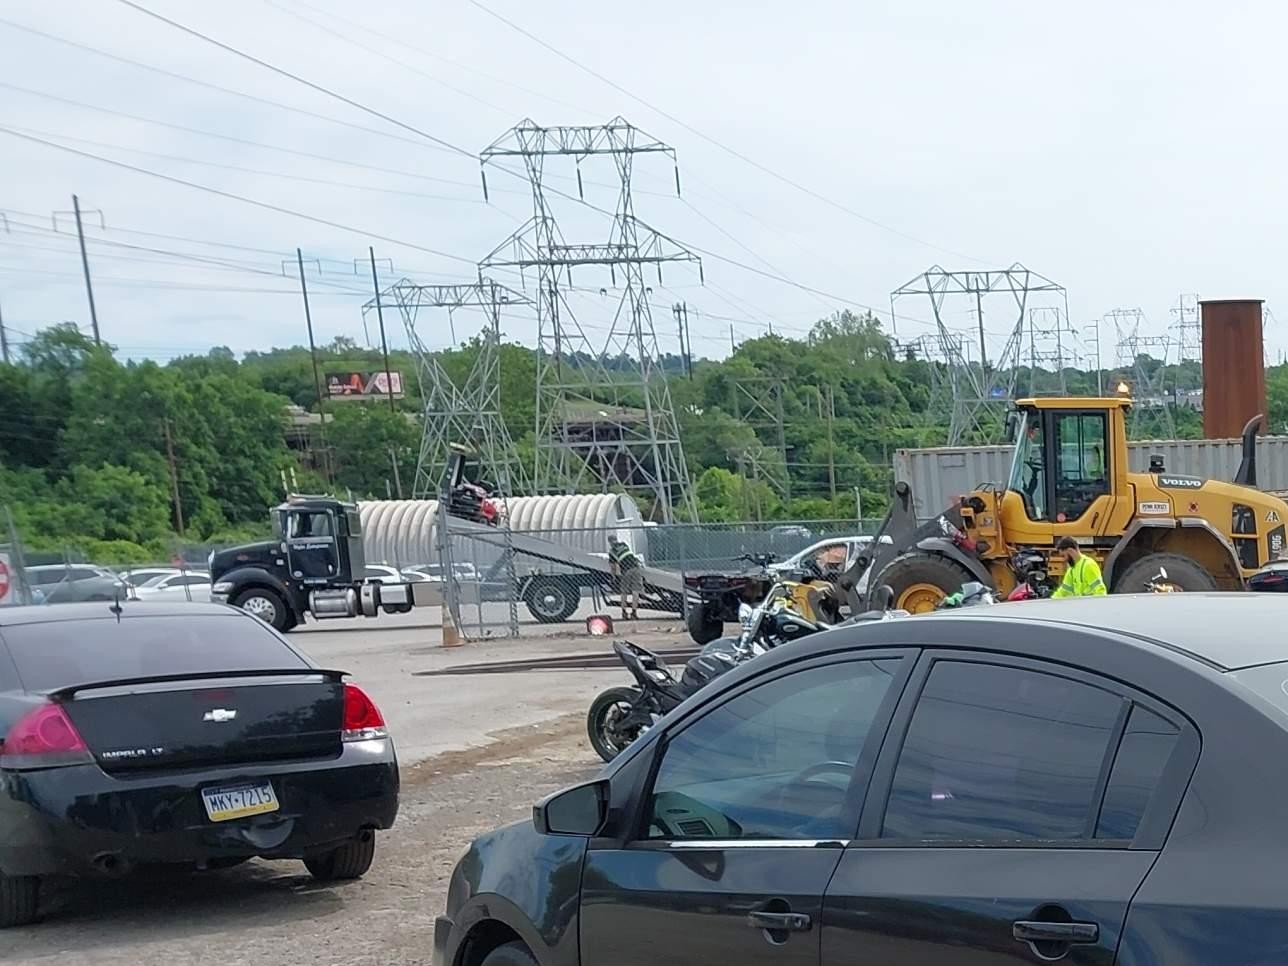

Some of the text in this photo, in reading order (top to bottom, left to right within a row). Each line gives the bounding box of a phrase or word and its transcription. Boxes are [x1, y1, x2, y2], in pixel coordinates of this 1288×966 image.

[1161, 478, 1202, 487] VOLVO
[102, 747, 163, 759] IMPALA LT
